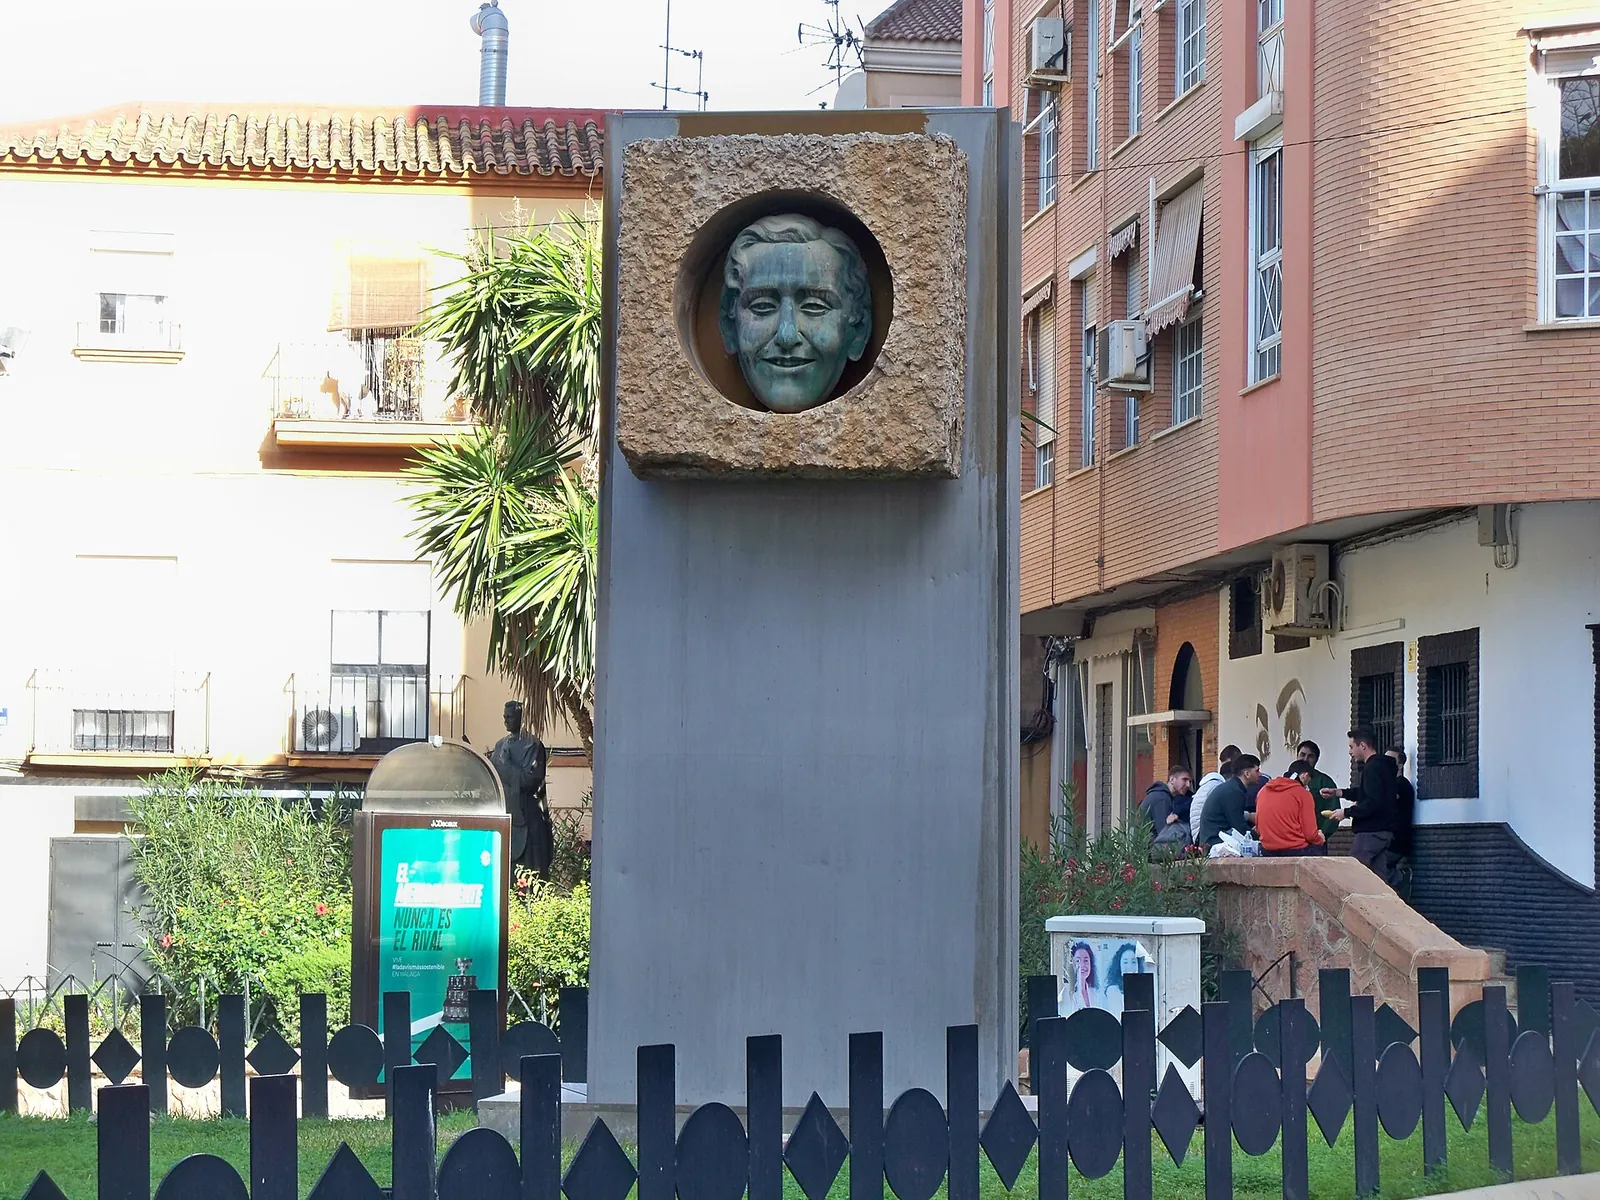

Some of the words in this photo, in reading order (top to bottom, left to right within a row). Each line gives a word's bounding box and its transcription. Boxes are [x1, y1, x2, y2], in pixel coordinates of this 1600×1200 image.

[393, 908, 434, 929] NUNCA
[437, 908, 453, 929] ES
[393, 930, 407, 951] EL
[411, 930, 443, 951] RIVAL
